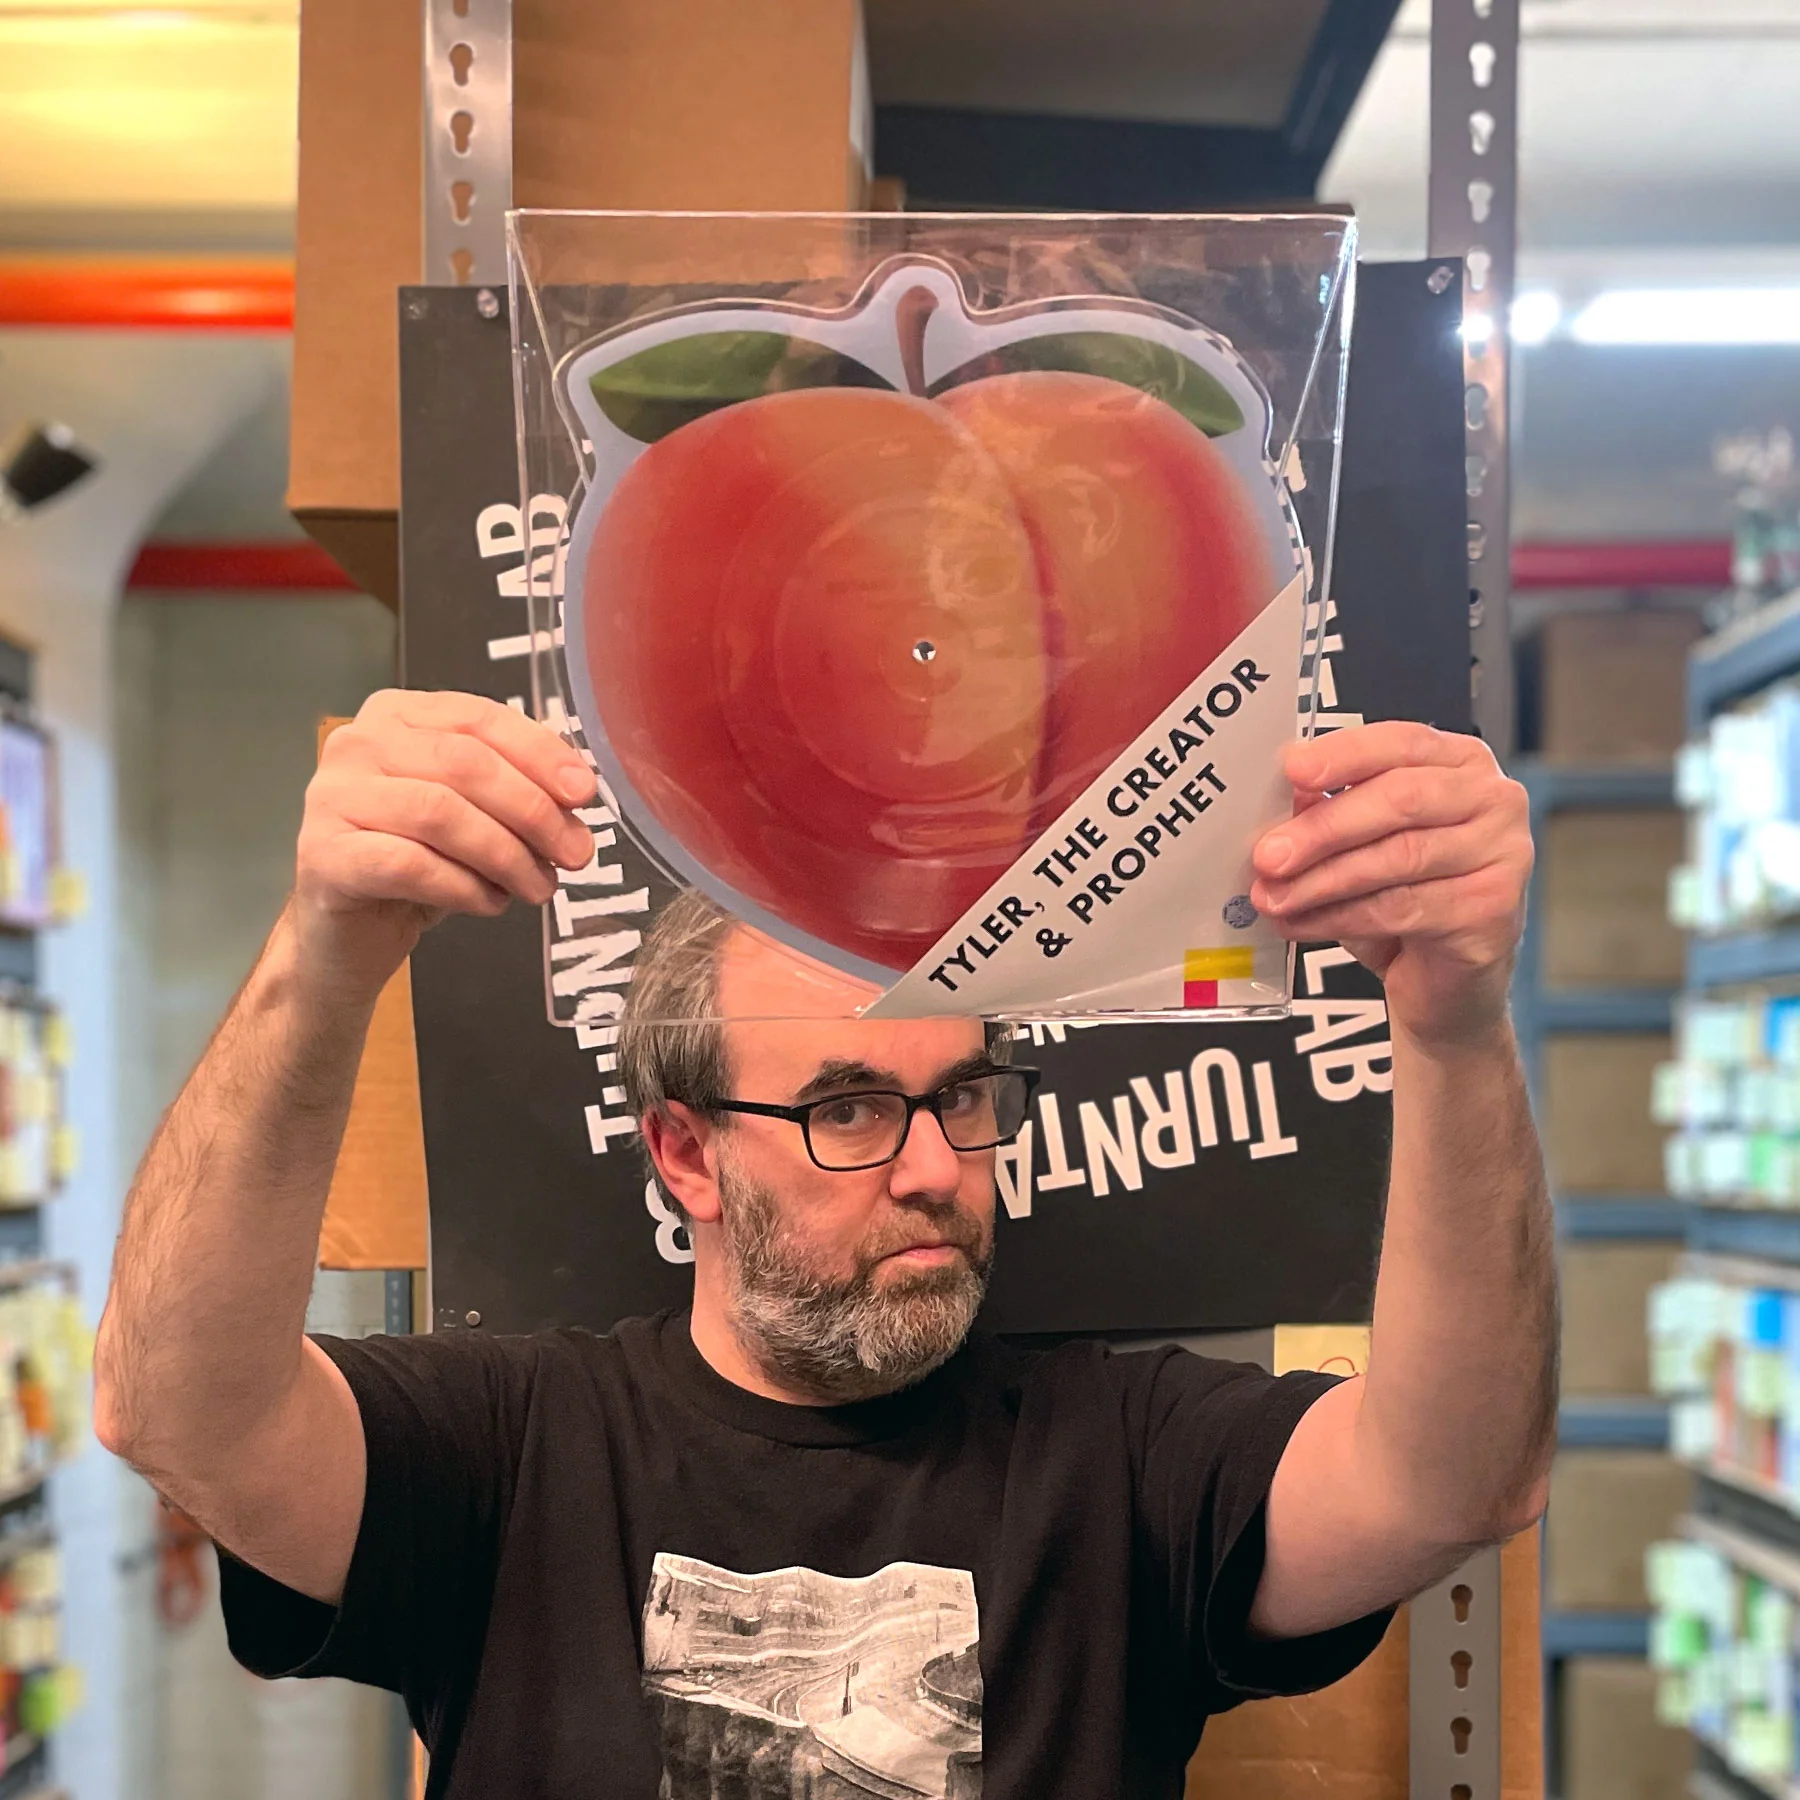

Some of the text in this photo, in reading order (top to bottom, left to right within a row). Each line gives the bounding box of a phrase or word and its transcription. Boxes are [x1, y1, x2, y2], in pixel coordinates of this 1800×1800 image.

[928, 895, 1046, 993] TYLER,
[1033, 817, 1108, 888] THE
[1106, 658, 1271, 817] CREATOR
[1035, 927, 1073, 958] &
[1066, 763, 1228, 925] PROPHET
[1292, 946, 1393, 1101] LAB
[995, 1047, 1298, 1219] TURNTA
